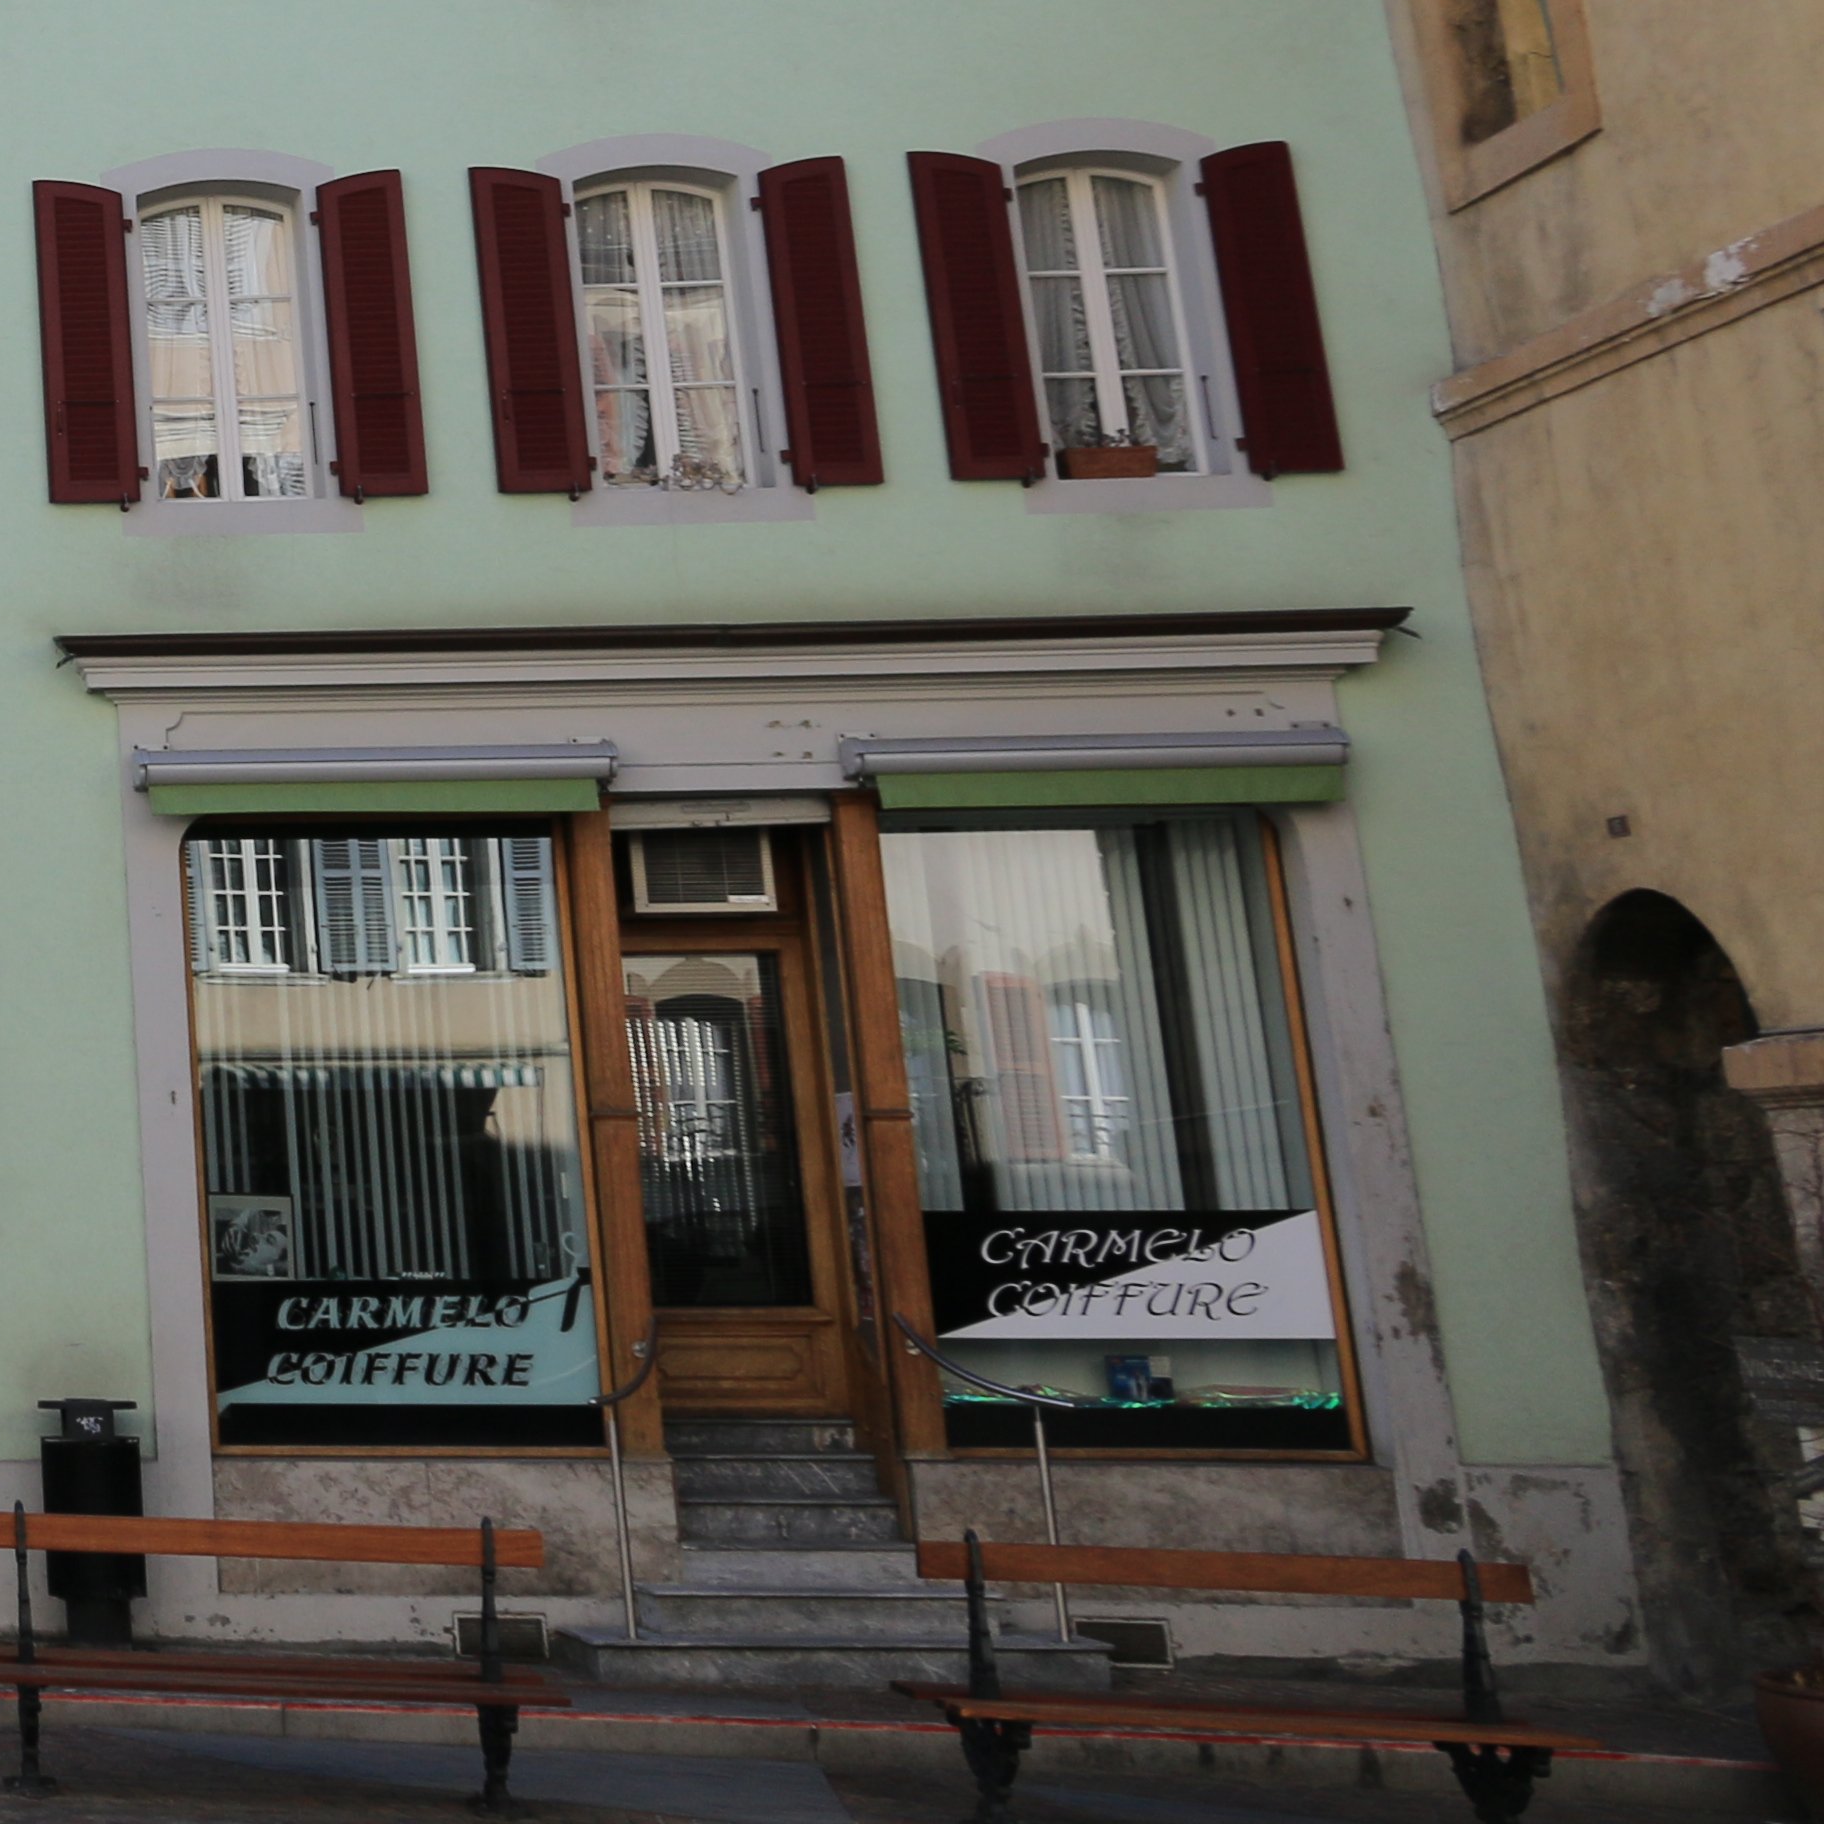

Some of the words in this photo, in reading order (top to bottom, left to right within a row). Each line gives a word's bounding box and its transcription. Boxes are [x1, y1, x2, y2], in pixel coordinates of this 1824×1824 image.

[981, 1227, 1256, 1269] CARMELO
[276, 1295, 533, 1330] CARMELO
[987, 1280, 1270, 1321] COIFFURE
[266, 1352, 534, 1387] COIFFURE
